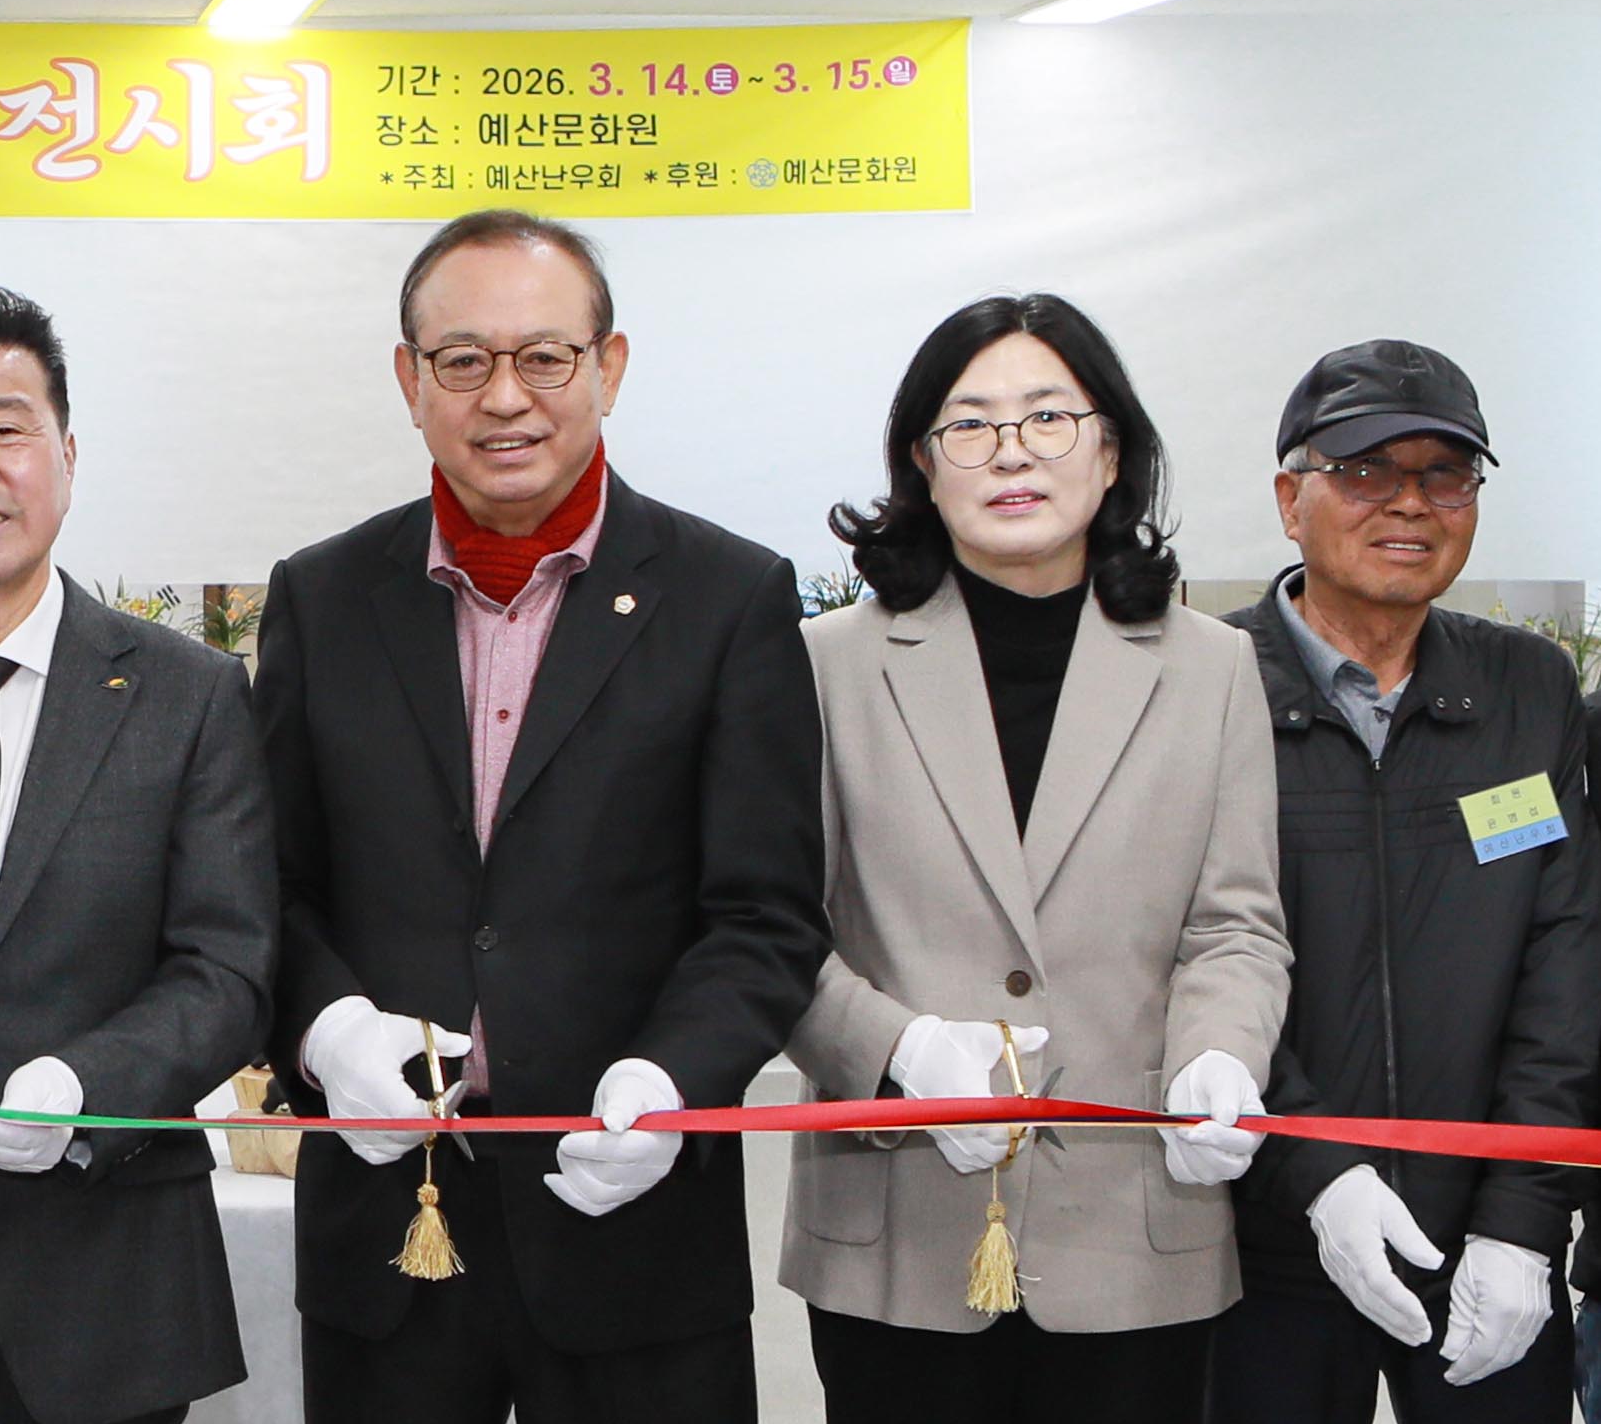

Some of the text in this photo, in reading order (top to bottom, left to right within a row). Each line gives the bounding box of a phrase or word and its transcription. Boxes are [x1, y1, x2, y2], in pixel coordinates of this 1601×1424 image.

[482, 67, 575, 96] 2026.
[478, 113, 658, 147] 예산문화원
[486, 163, 621, 191] 예산난우회
[783, 156, 917, 185] 예산문화원
